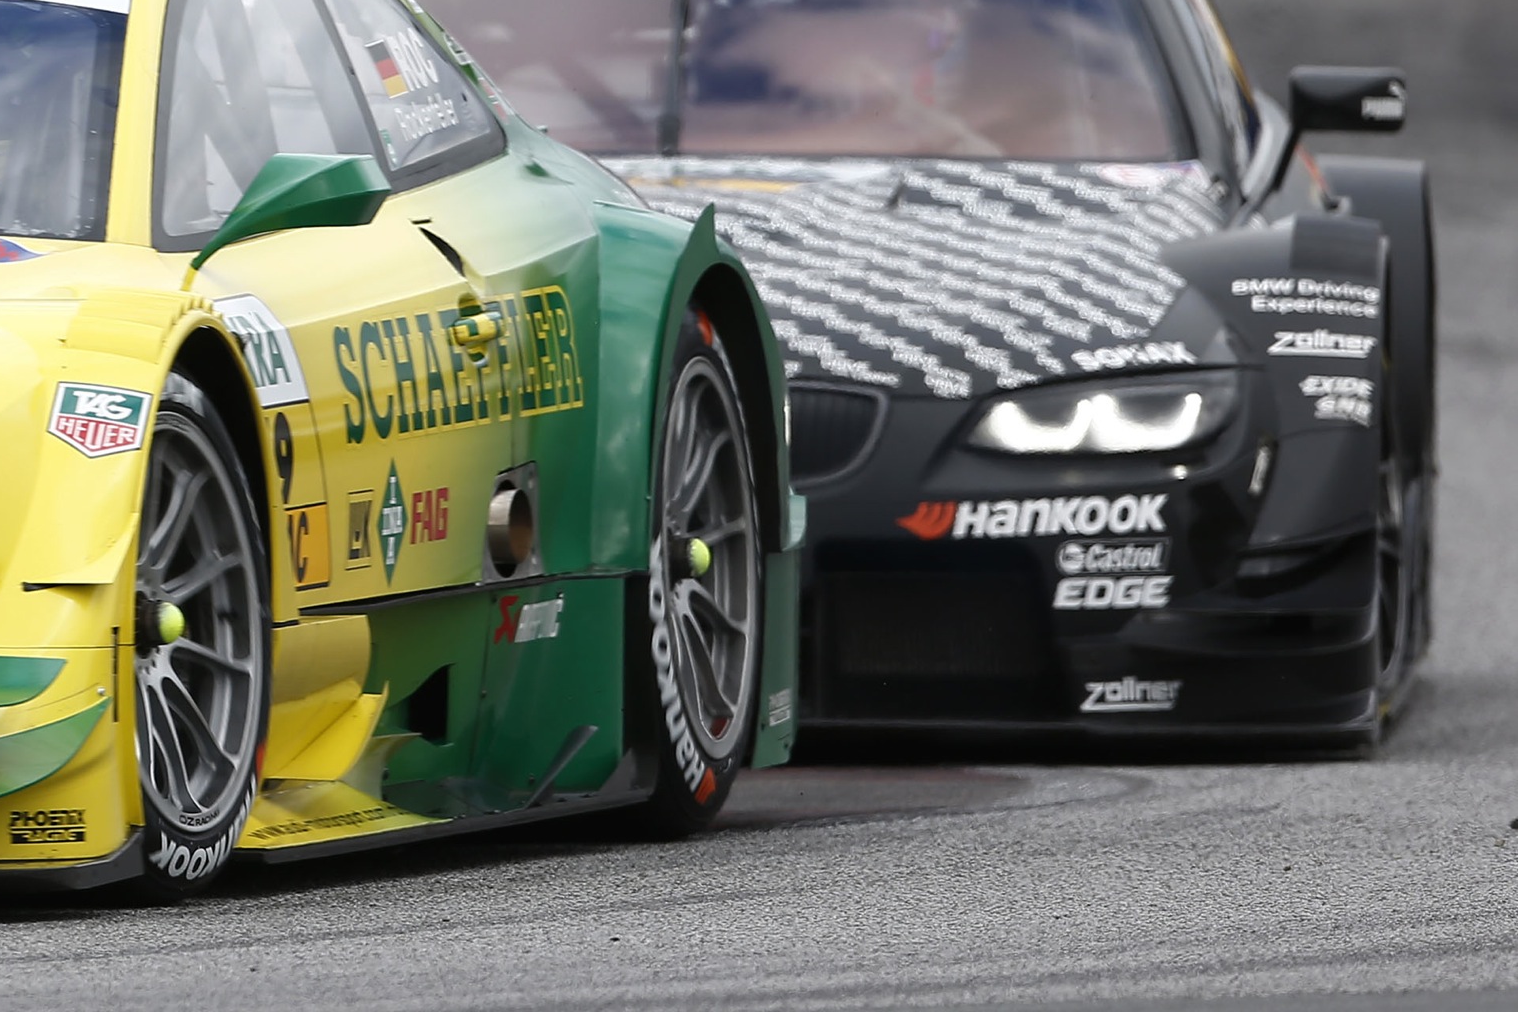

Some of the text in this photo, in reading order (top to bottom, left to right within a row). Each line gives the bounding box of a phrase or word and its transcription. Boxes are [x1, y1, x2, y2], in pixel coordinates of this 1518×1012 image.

[1232, 277, 1380, 304] BMW Driving
[1251, 295, 1379, 320] Experience
[73, 390, 133, 420] TAG
[56, 416, 138, 451] HEUER
[265, 412, 293, 505] 9
[409, 486, 449, 545] FAG
[1085, 542, 1163, 571] Castrol
[1052, 575, 1174, 610] EDGE
